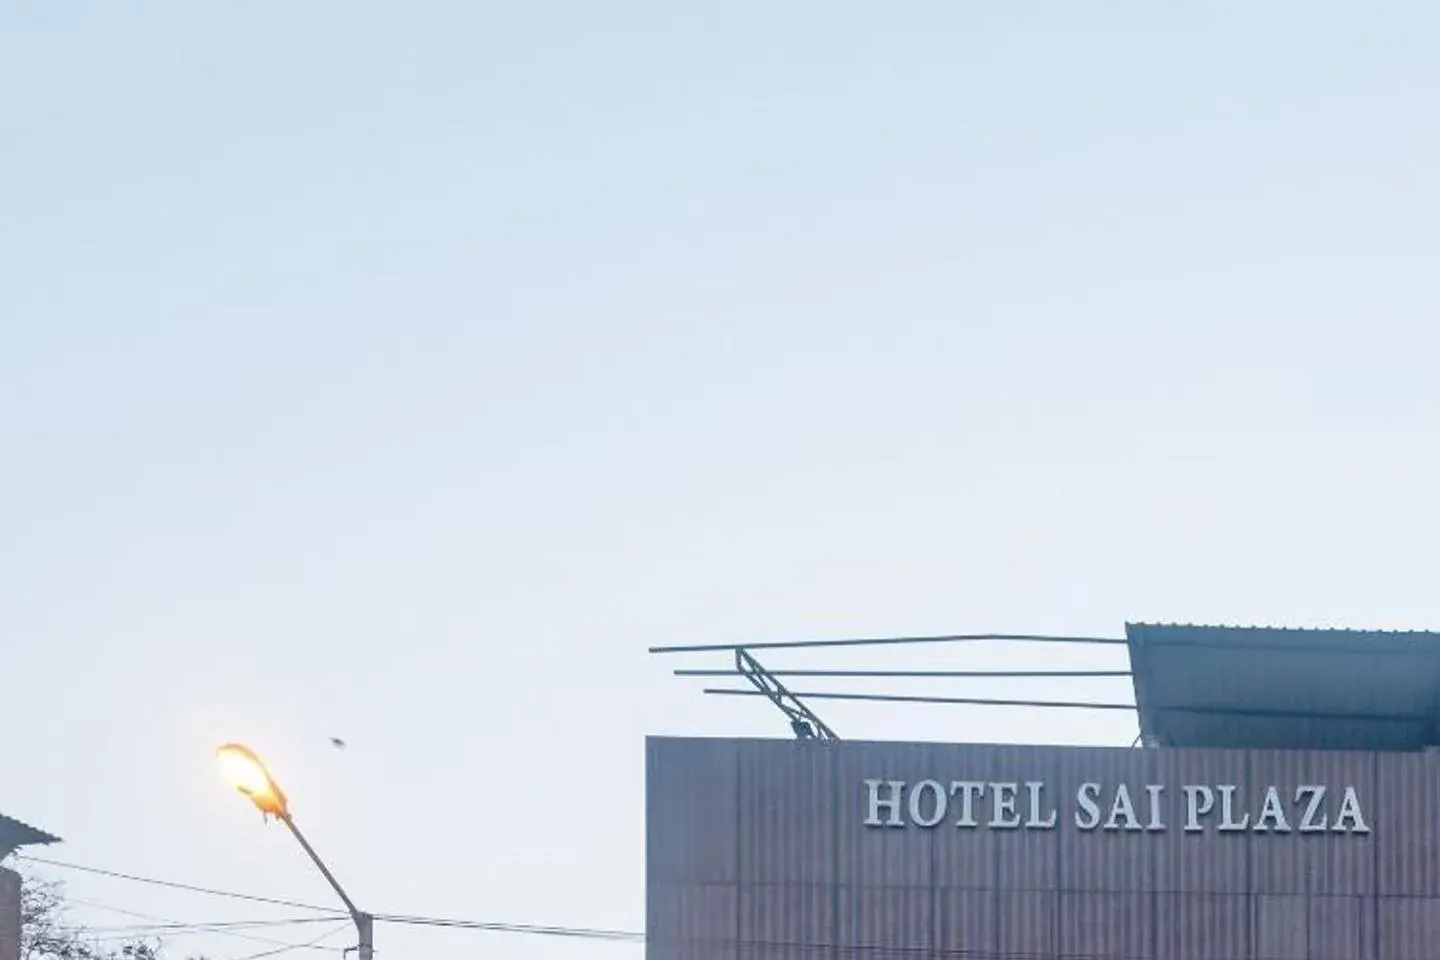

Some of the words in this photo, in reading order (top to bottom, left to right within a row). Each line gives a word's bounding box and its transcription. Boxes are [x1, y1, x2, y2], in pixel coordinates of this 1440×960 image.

[863, 779, 1057, 830] HOTEL
[1075, 782, 1166, 831] SAI
[1183, 785, 1371, 833] PLAZA
